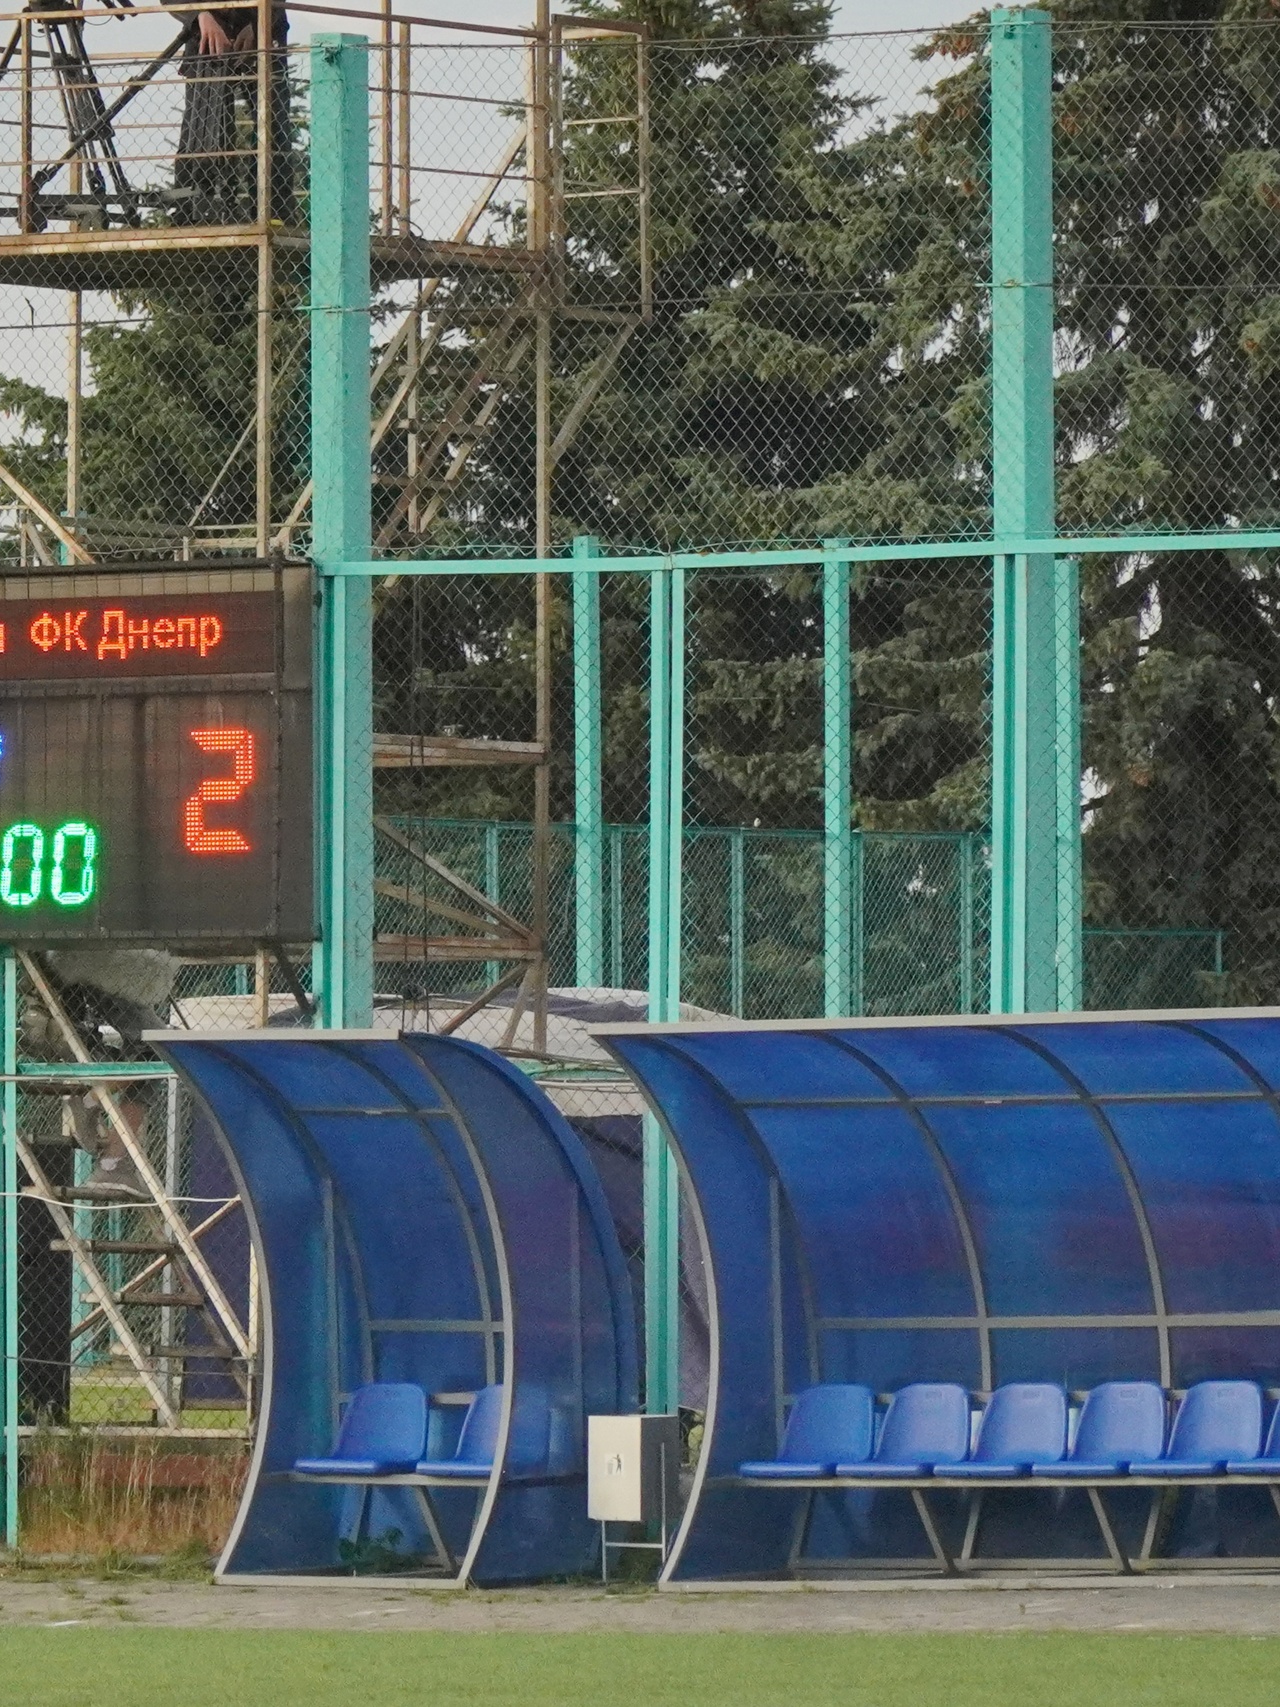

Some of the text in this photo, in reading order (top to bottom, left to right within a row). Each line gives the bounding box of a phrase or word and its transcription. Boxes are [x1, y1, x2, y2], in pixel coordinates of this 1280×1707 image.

[29, 611, 88, 652] ФК
[97, 609, 223, 660] Днепр
[184, 727, 256, 854] 2
